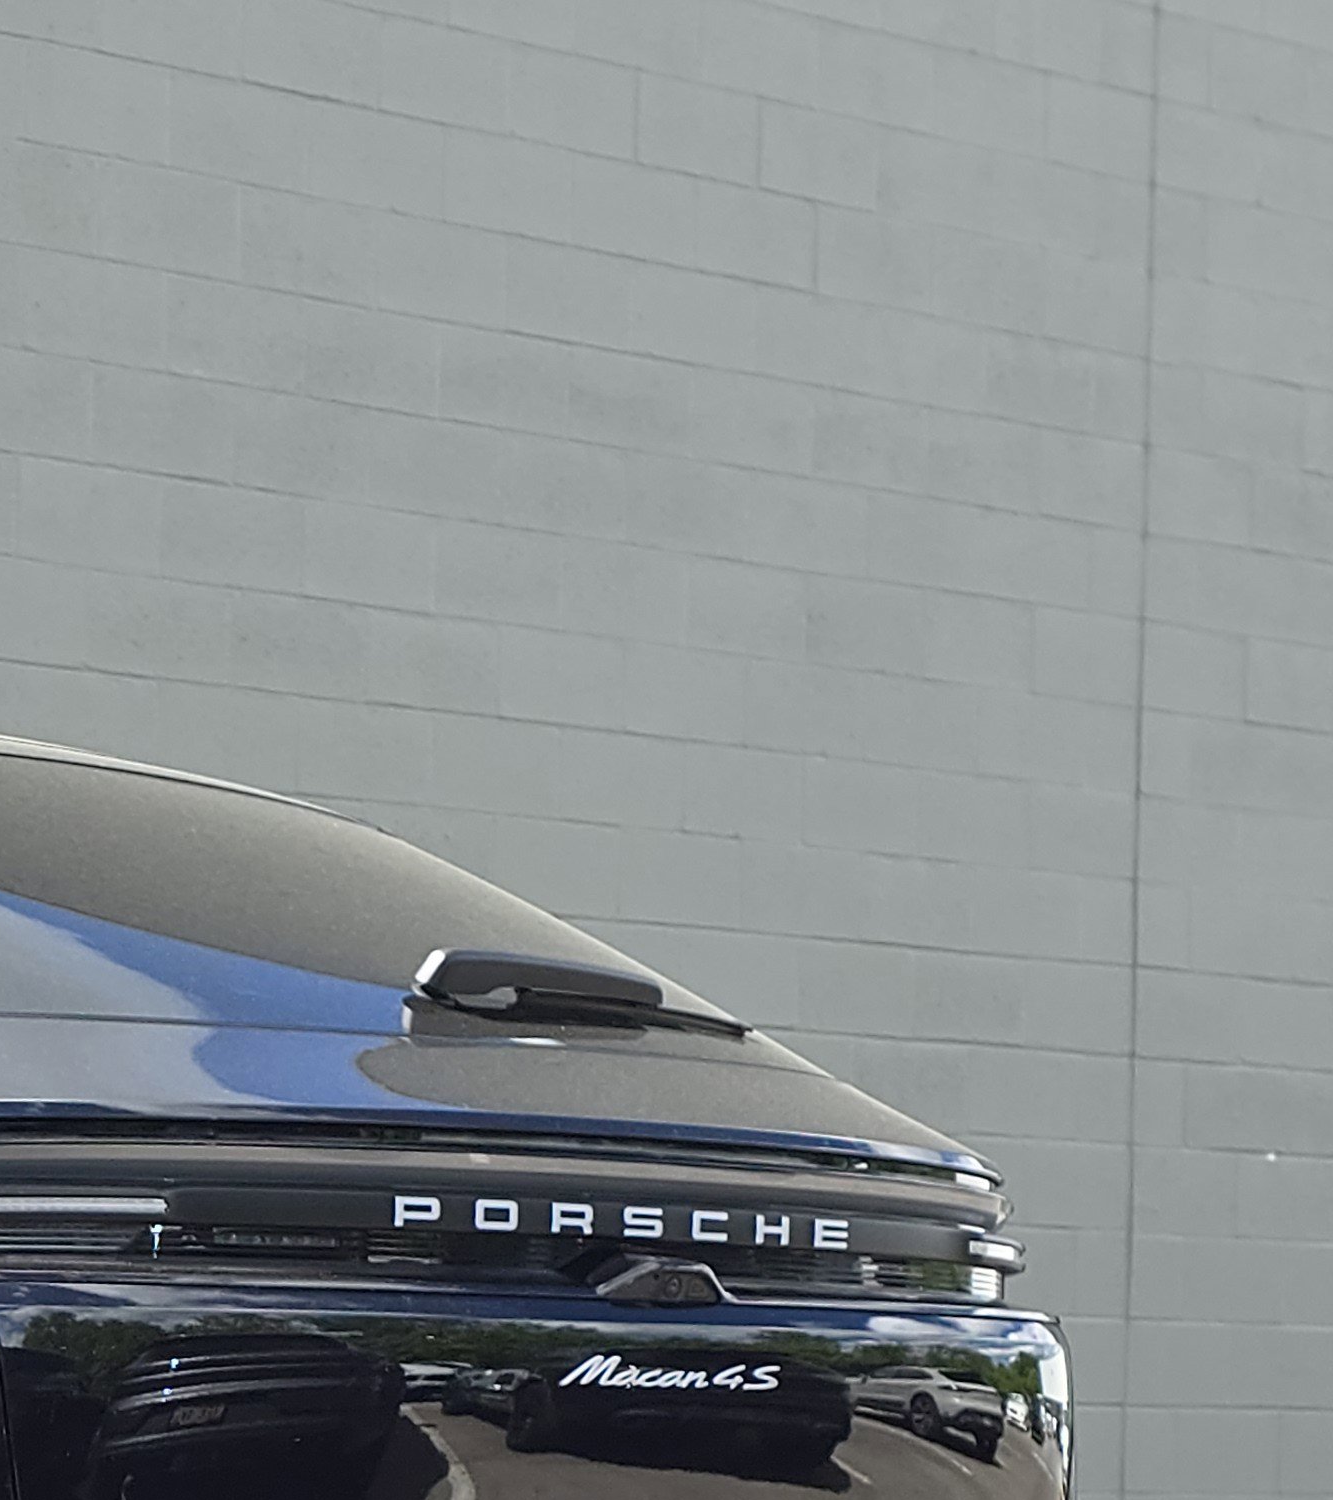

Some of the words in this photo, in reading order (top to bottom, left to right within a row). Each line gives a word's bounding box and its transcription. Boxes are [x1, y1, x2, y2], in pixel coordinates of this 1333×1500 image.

[393, 1195, 850, 1251] PORSCHE
[559, 1354, 709, 1389] Macan
[712, 1364, 781, 1391] 4S
